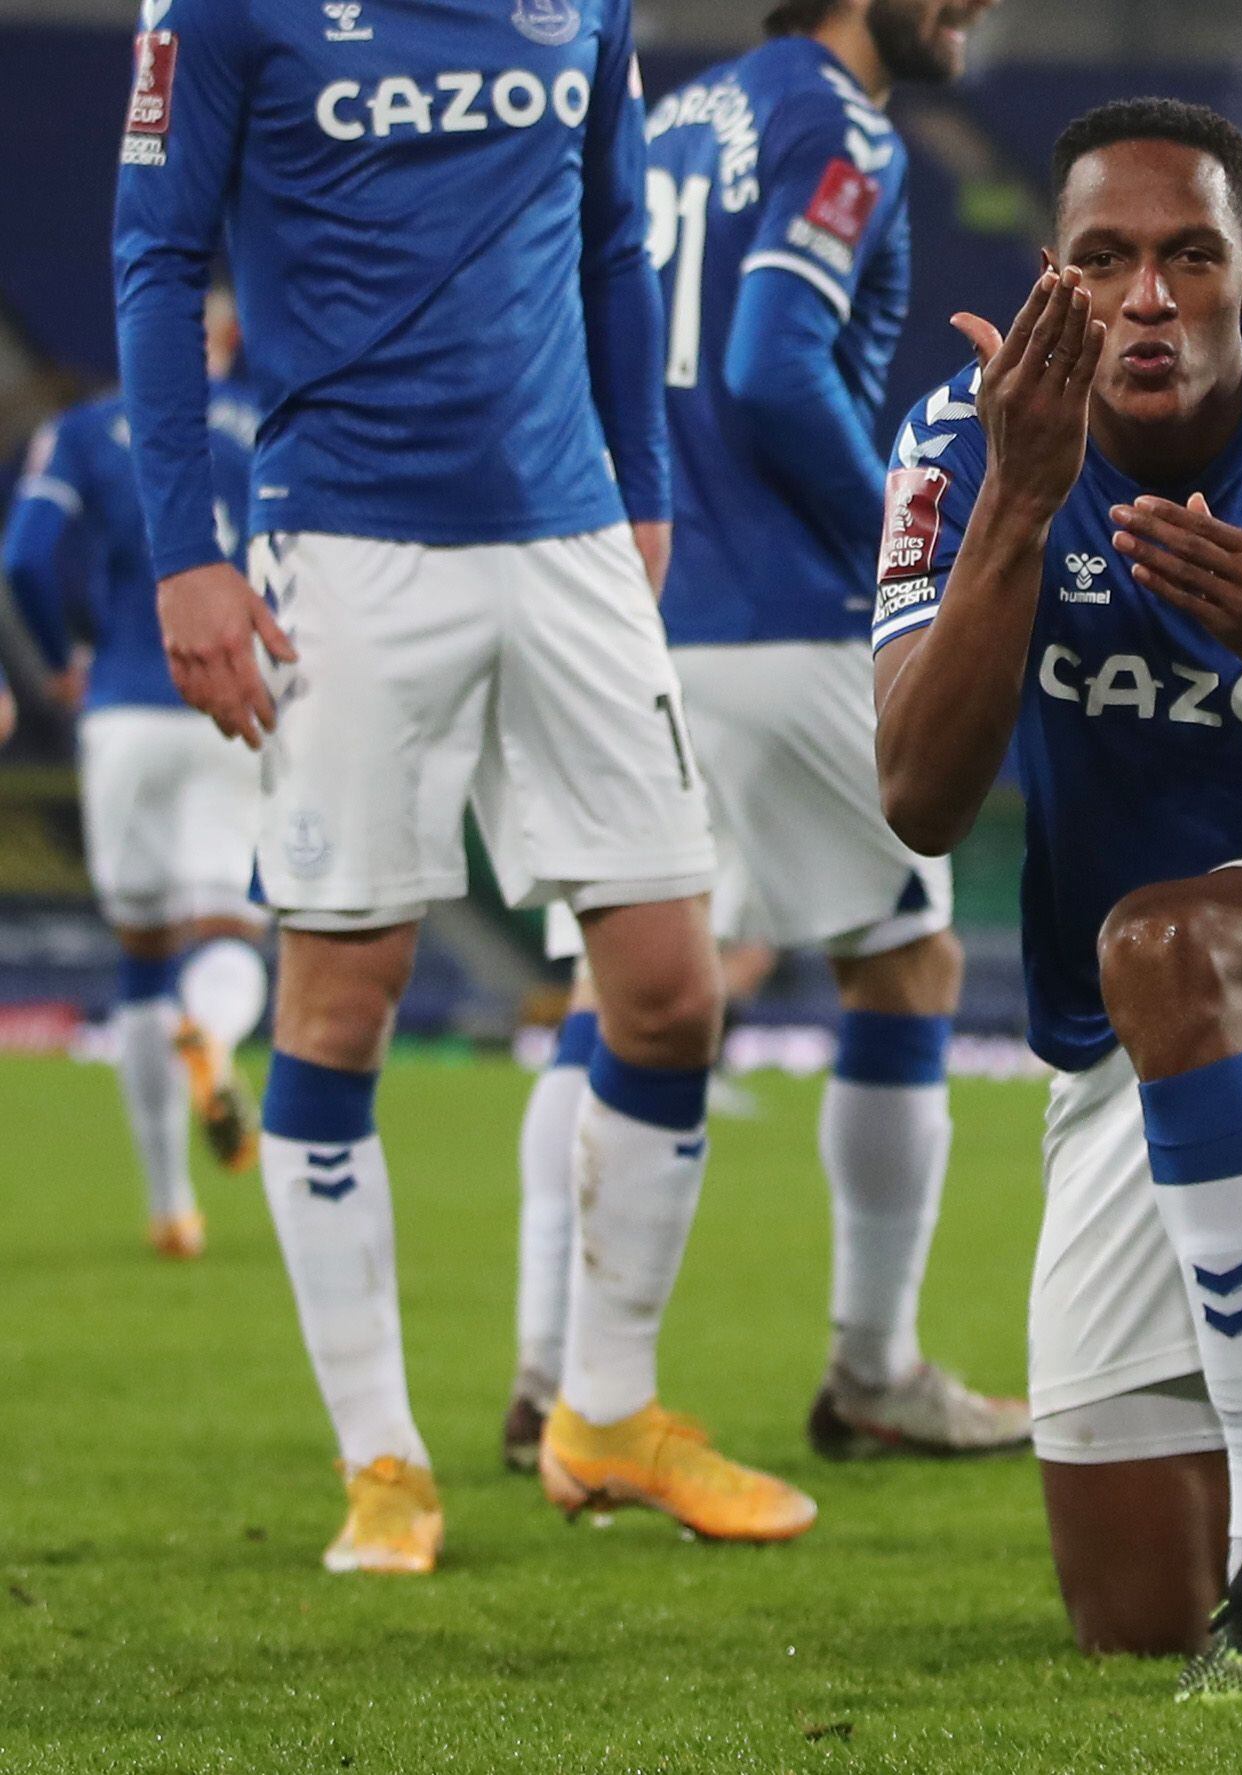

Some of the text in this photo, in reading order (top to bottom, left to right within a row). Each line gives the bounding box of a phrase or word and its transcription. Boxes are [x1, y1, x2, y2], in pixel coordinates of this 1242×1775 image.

[316, 69, 591, 141] CAZOO
[888, 548, 923, 568] CUP
[881, 576, 929, 601] room
[1060, 587, 1111, 605] hummel
